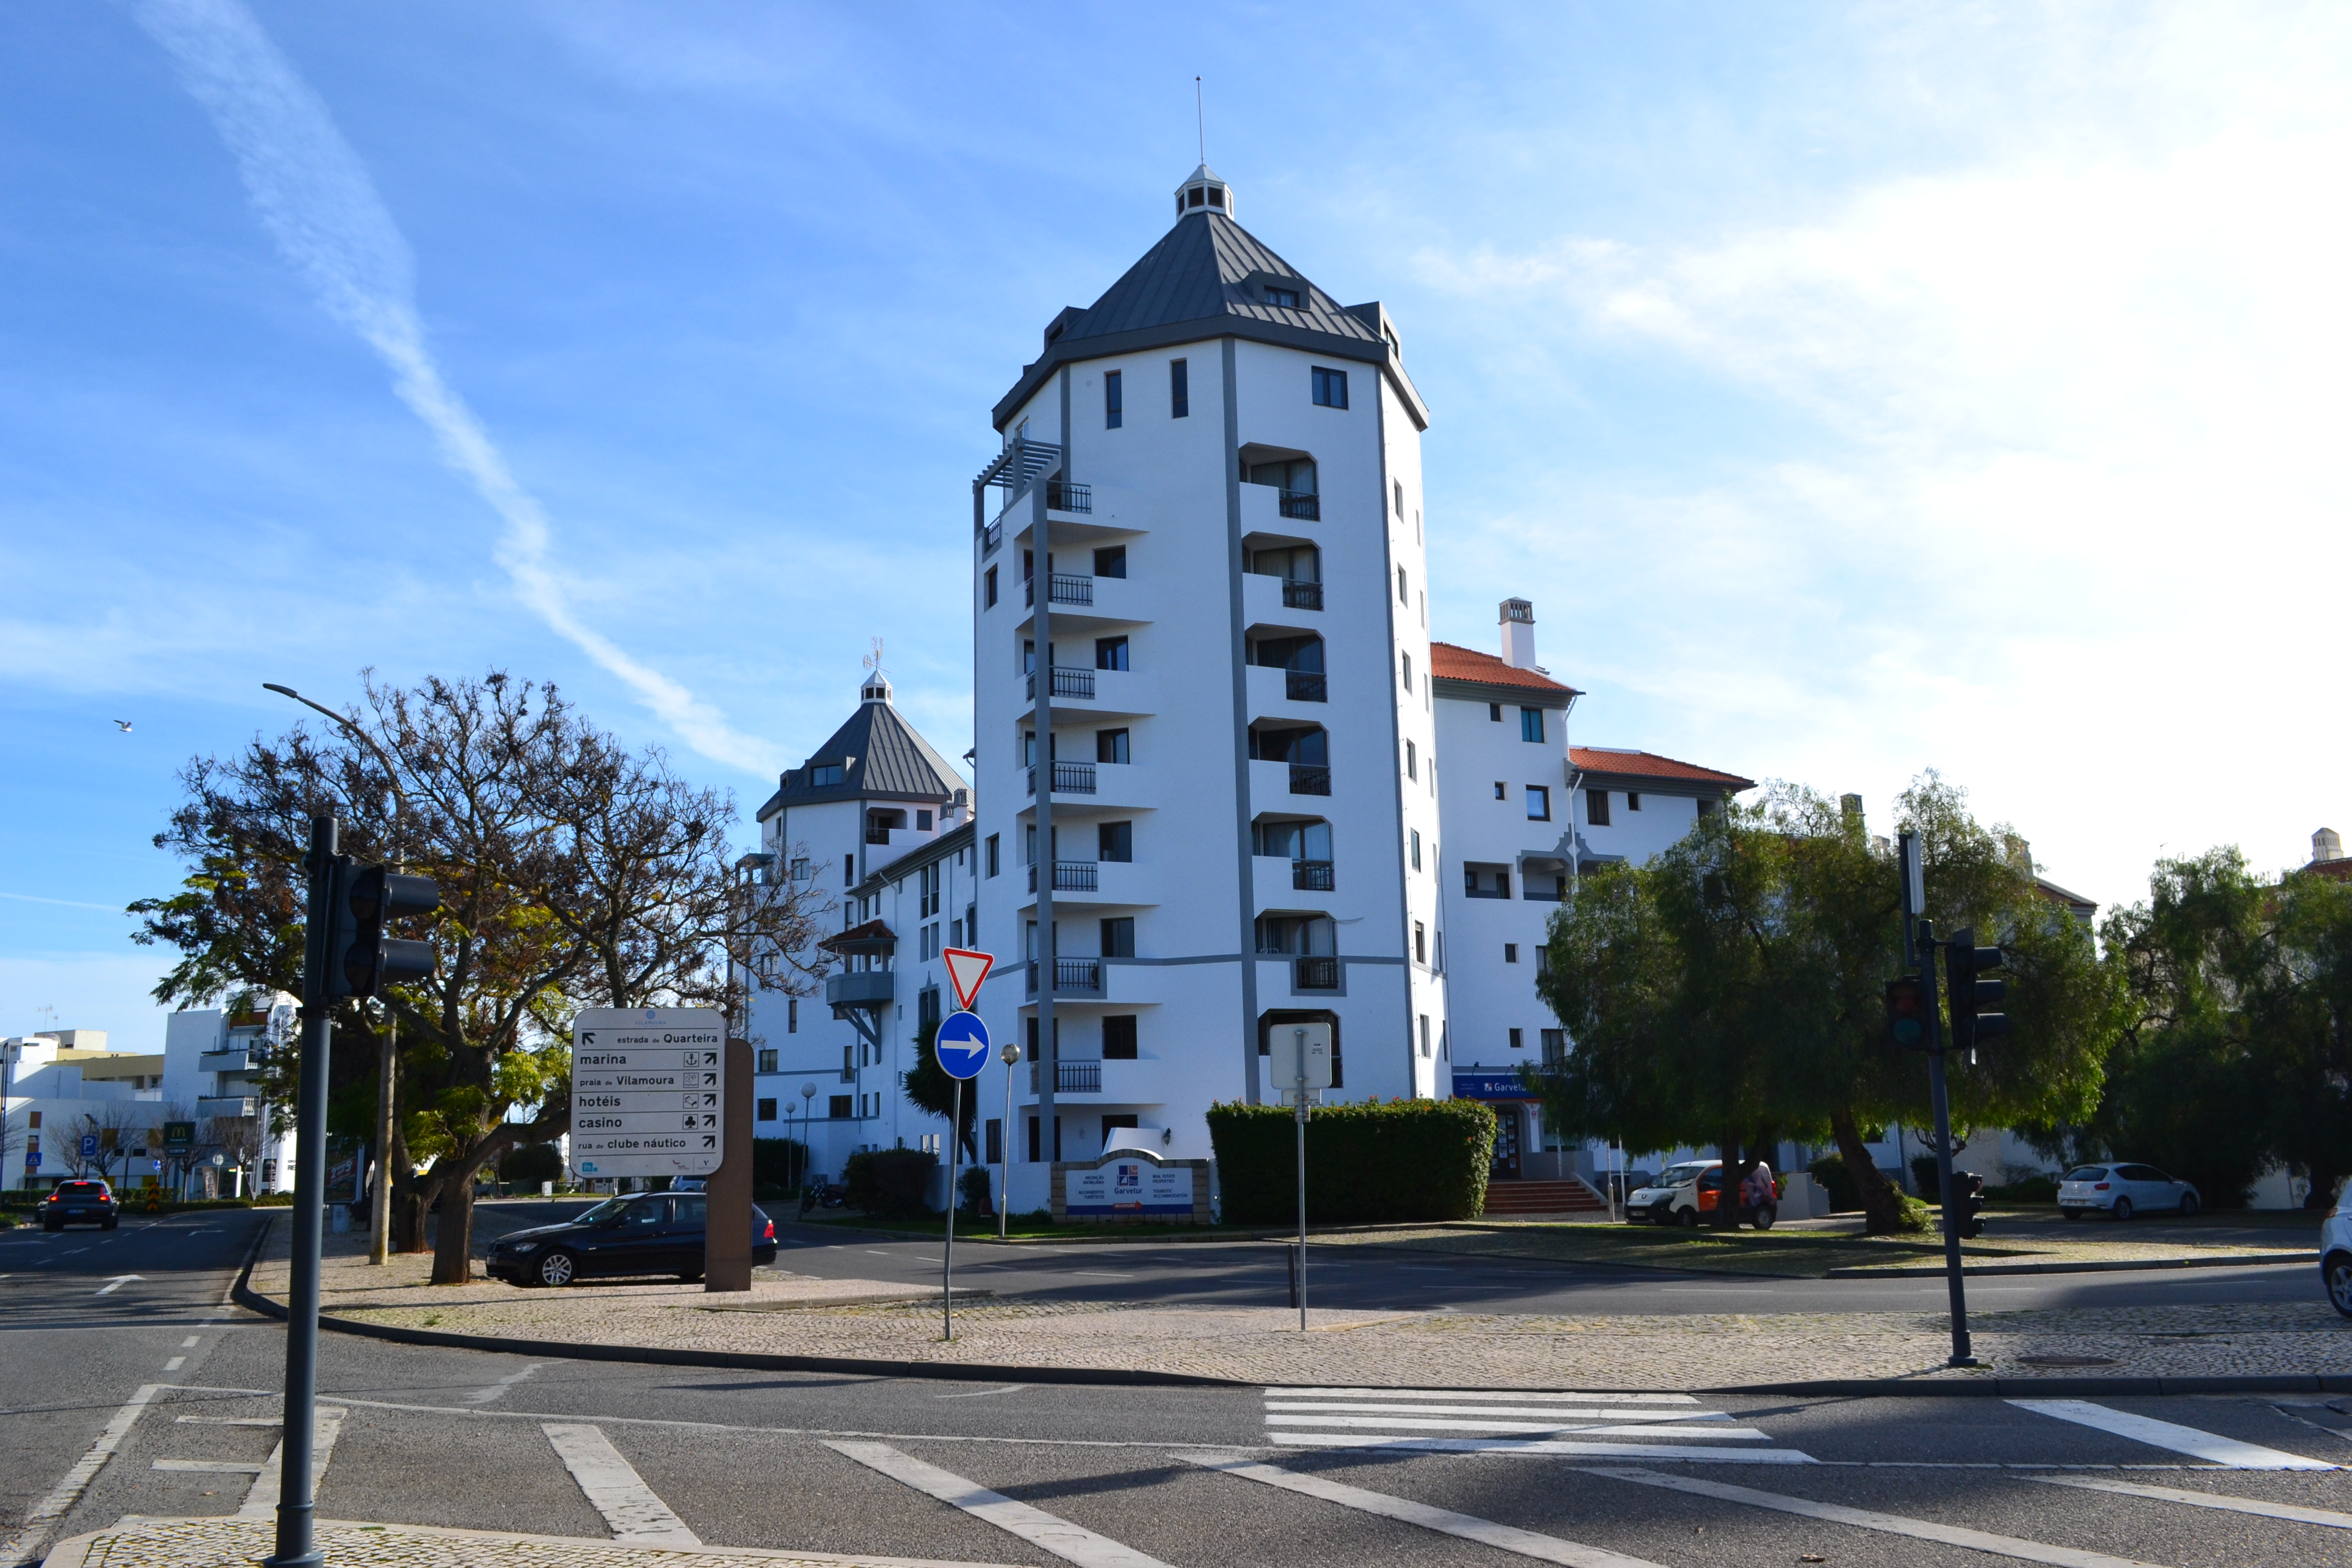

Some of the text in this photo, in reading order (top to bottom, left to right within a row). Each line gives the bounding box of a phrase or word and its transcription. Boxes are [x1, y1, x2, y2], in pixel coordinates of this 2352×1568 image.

[664, 1034, 718, 1043] Quarteira
[580, 1054, 626, 1065] marina
[580, 1079, 601, 1087] praia
[617, 1075, 674, 1085] Vilamoura
[1494, 1083, 1526, 1091] Garvetu
[579, 1096, 621, 1107] hotéis
[578, 1117, 622, 1128] casino
[84, 1138, 93, 1150] P
[607, 1139, 640, 1148] clube
[643, 1138, 686, 1148] náutico
